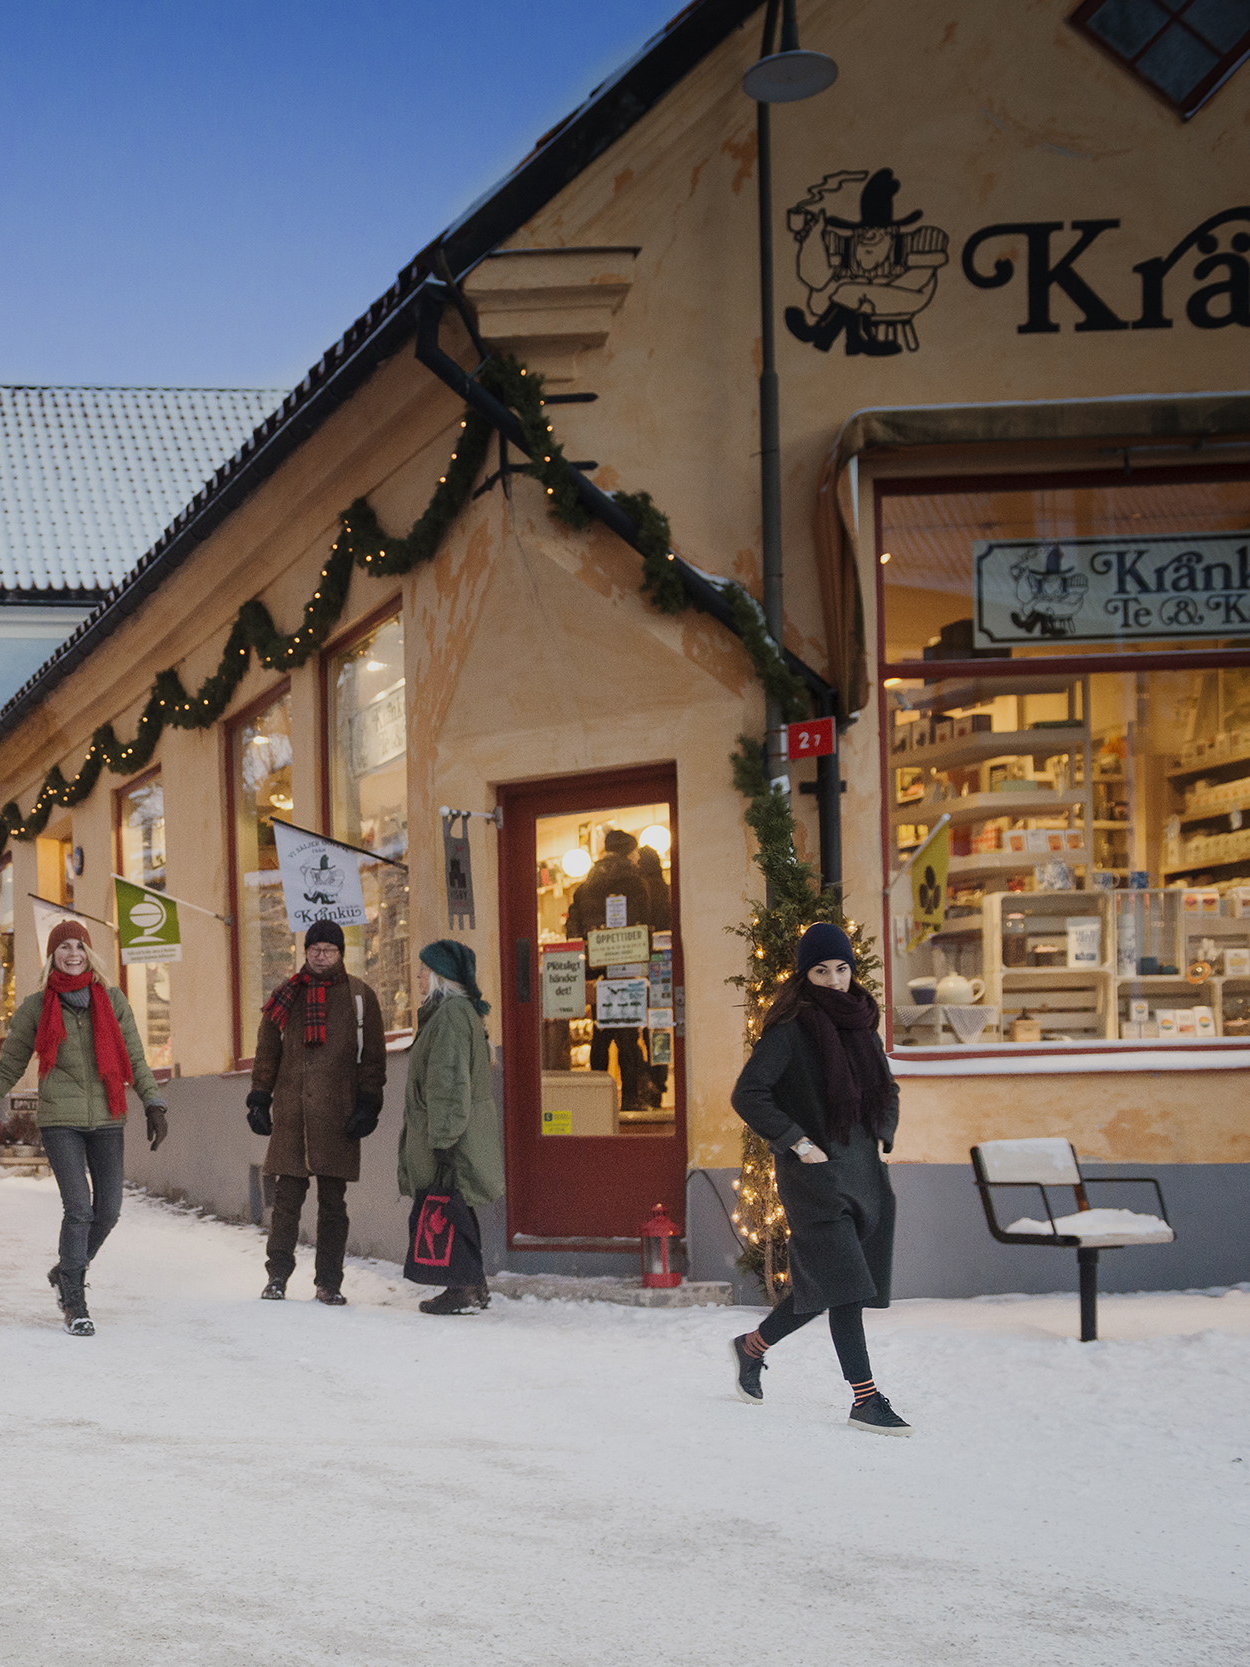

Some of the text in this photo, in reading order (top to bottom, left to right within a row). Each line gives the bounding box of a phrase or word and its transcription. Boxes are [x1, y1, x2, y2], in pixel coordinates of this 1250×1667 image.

[1105, 596, 1153, 629] Te
[1160, 595, 1205, 626] &
[596, 930, 642, 944] ÖPPETTIDER
[555, 986, 572, 996] det!
